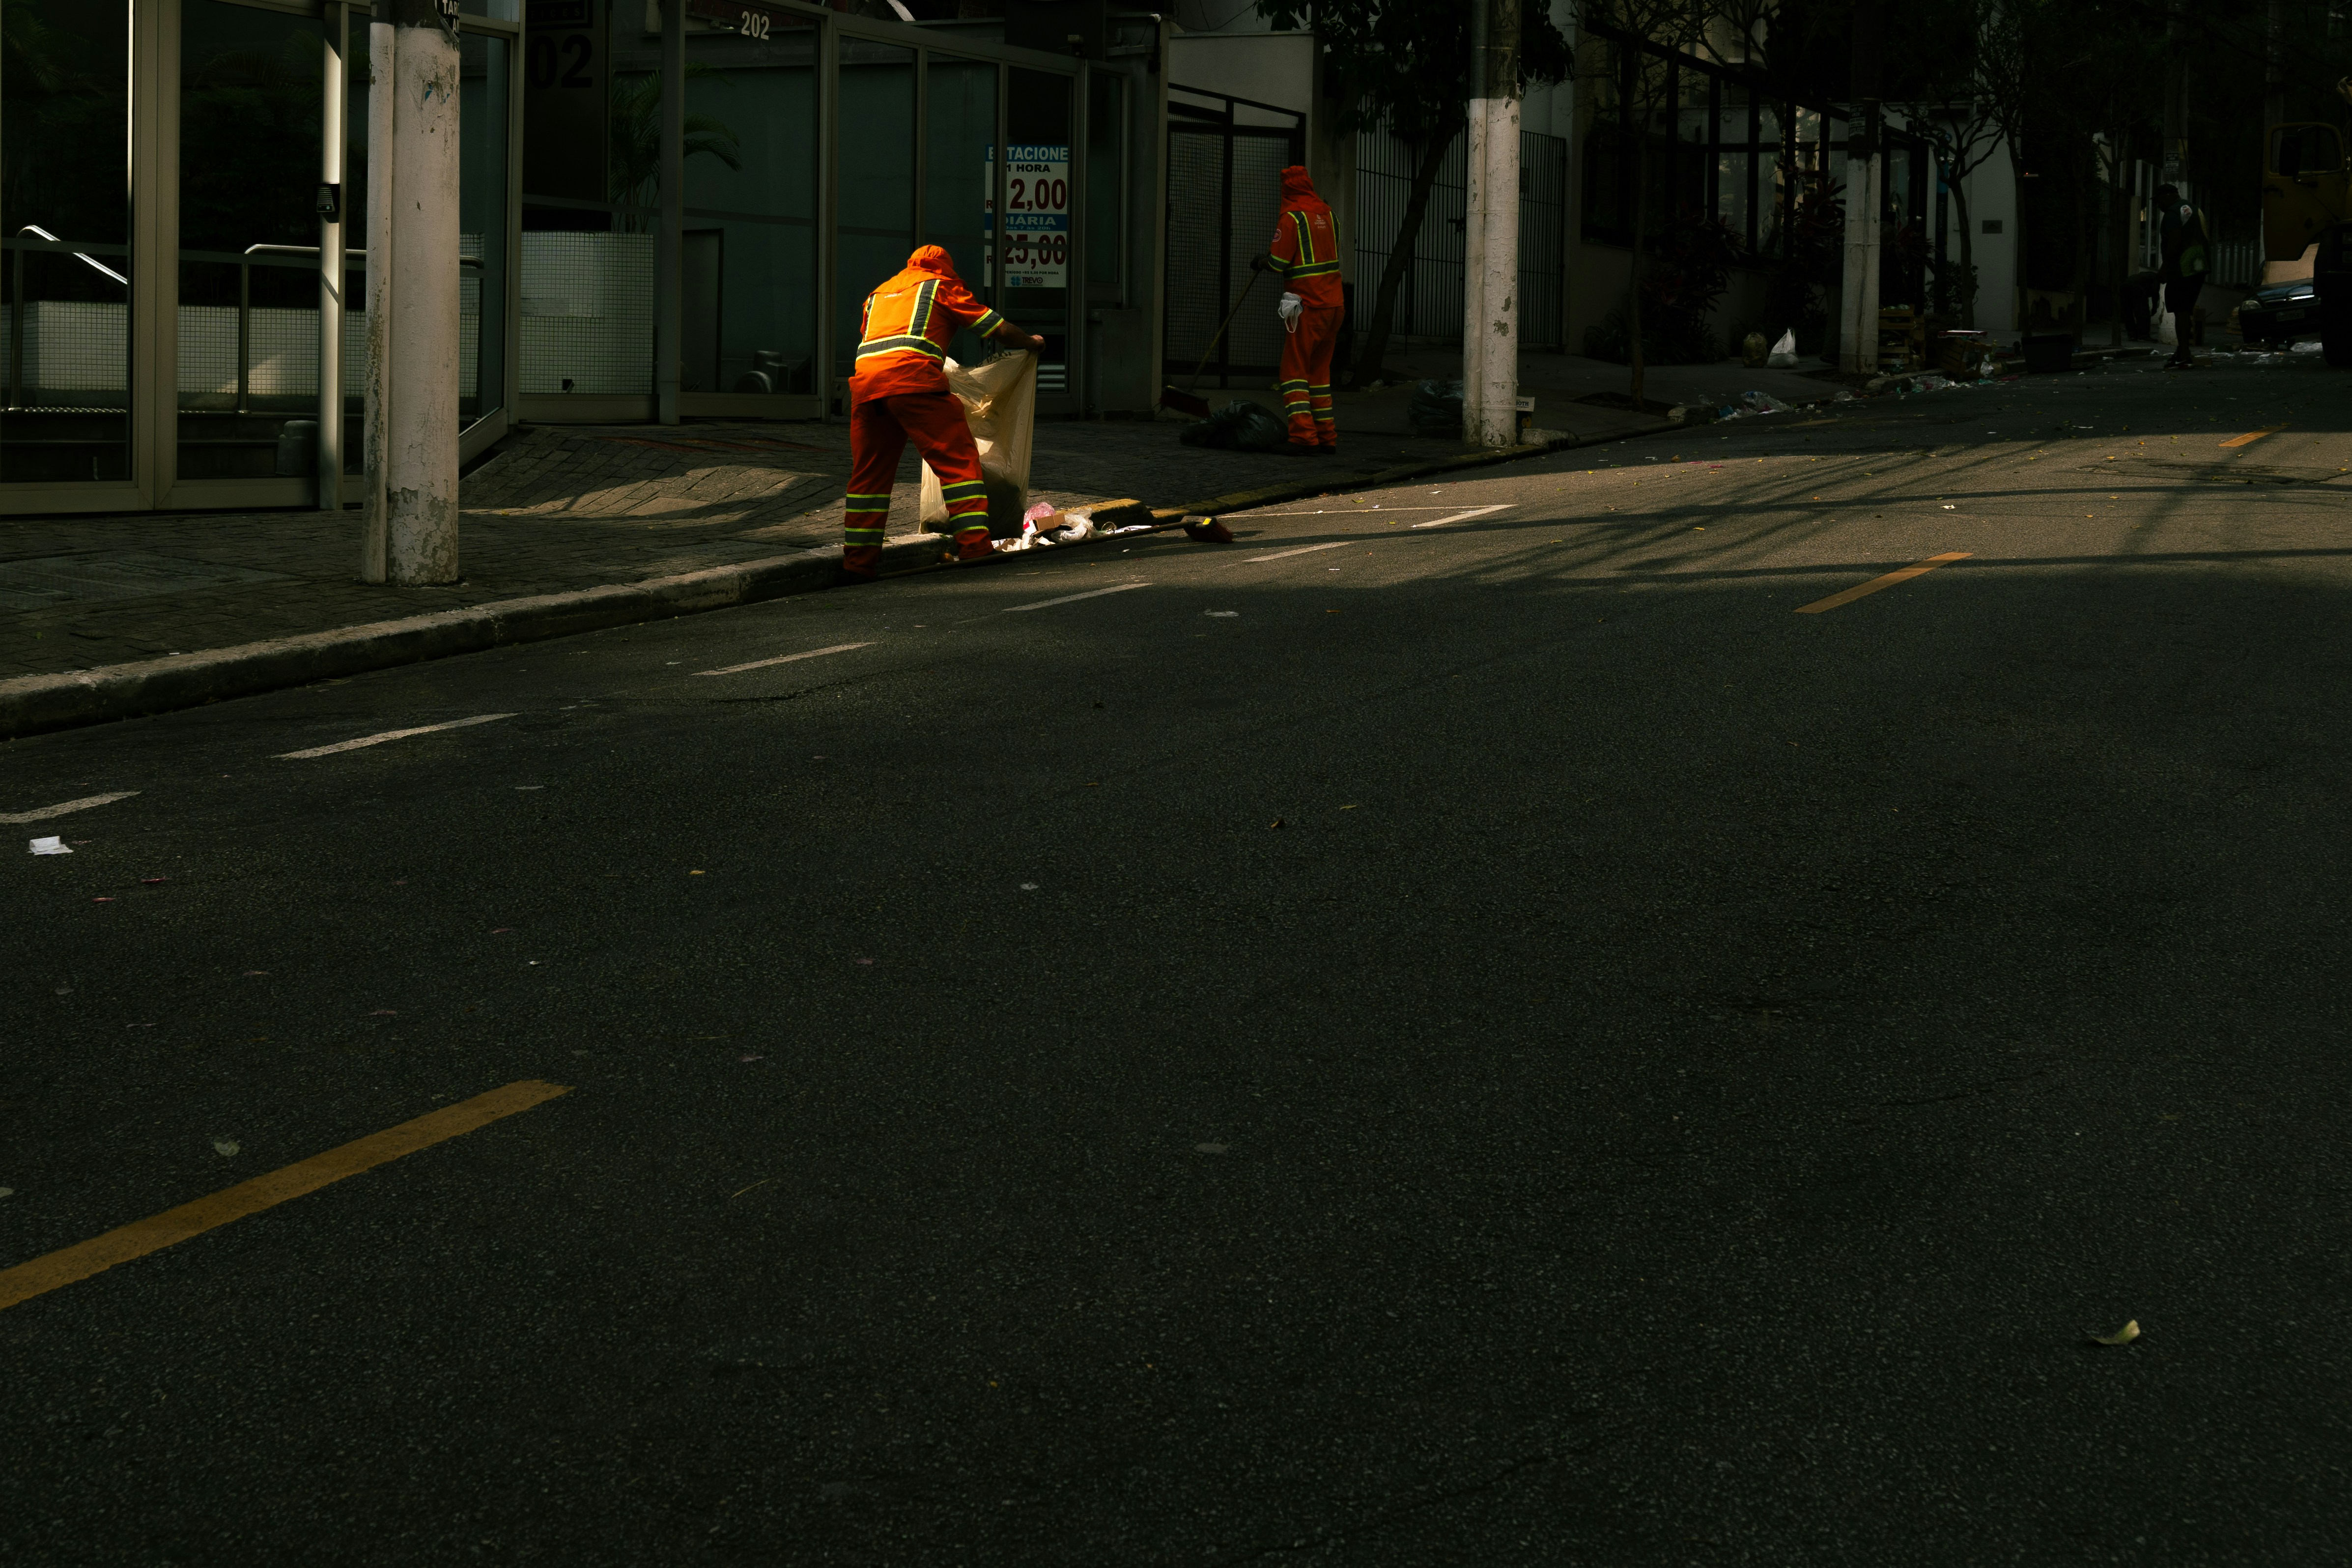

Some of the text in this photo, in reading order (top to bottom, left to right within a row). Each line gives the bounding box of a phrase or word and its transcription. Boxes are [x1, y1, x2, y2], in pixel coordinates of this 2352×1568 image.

[741, 11, 769, 40] 202
[529, 35, 593, 89] 02
[988, 146, 1068, 161] ETACIONE
[1010, 178, 1067, 212] 2,00
[1006, 234, 1066, 270] 25,00
